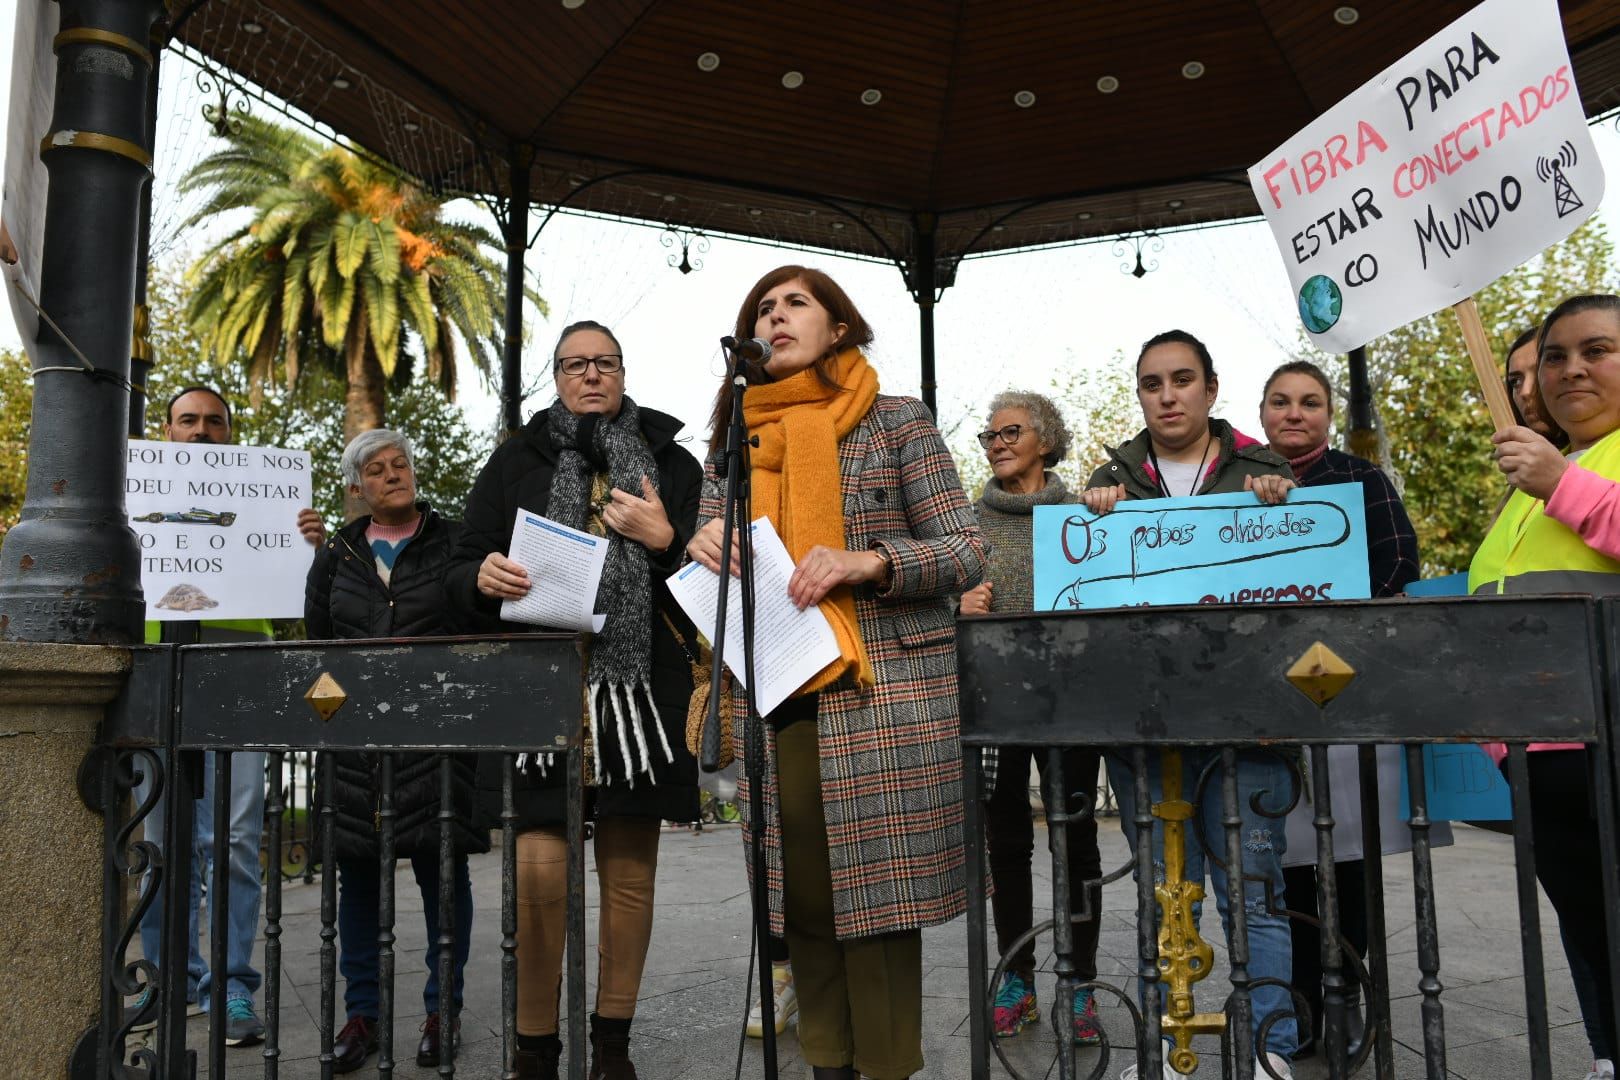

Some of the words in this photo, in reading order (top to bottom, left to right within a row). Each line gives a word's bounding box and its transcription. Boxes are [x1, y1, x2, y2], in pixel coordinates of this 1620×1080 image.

[1263, 120, 1388, 209] FIBRA
[1396, 32, 1500, 131] PARA
[1291, 188, 1383, 264] ESTAR
[1393, 66, 1570, 198] CONECTADOS
[1345, 254, 1379, 287] CO
[1414, 175, 1522, 270] MUNDO
[128, 448, 163, 463] FOI
[175, 451, 191, 466] O
[203, 451, 249, 468] QUE
[262, 454, 304, 471] NOS
[126, 478, 172, 495] DEU
[188, 481, 300, 499] MOVISTAR
[1219, 510, 1316, 543] olvidados
[176, 534, 189, 550] E
[209, 534, 225, 550] O
[246, 533, 292, 552] QUE
[144, 557, 223, 573] TEMOS
